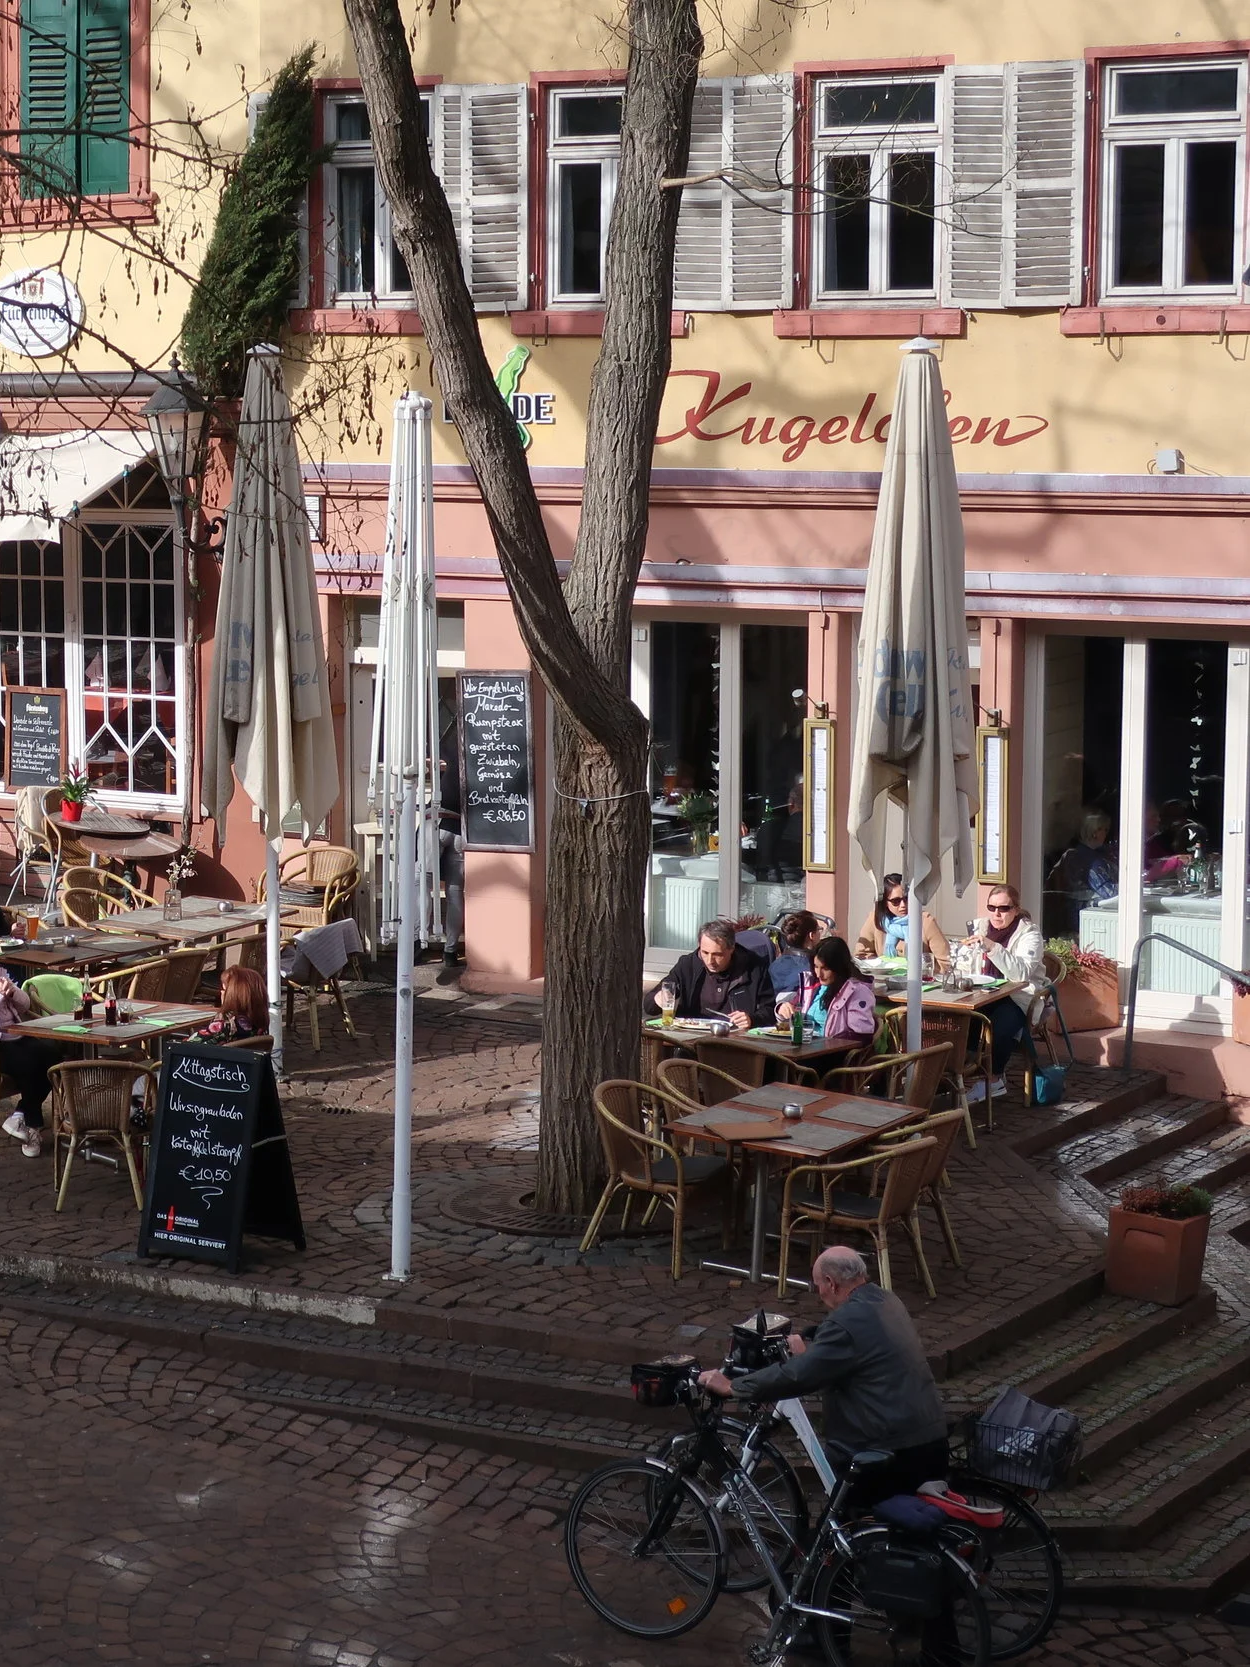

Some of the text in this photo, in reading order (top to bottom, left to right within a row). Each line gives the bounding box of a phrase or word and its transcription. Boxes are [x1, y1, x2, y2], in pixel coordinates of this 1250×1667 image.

[653, 370, 1049, 463] Kugelen
[463, 679, 525, 699] Wir Empfehlen!
[465, 712, 524, 731] Rumpsteak
[482, 729, 501, 741] mit
[488, 782, 507, 793] und
[468, 790, 529, 811] Bratkartoffeln
[172, 1057, 248, 1083] Mittagstisch
[190, 1124, 212, 1139] mit
[156, 1212, 168, 1220] DAS
[174, 1215, 200, 1225] ORIGINAL
[154, 1231, 227, 1250] HIER ORIGINAL SERVIERT
